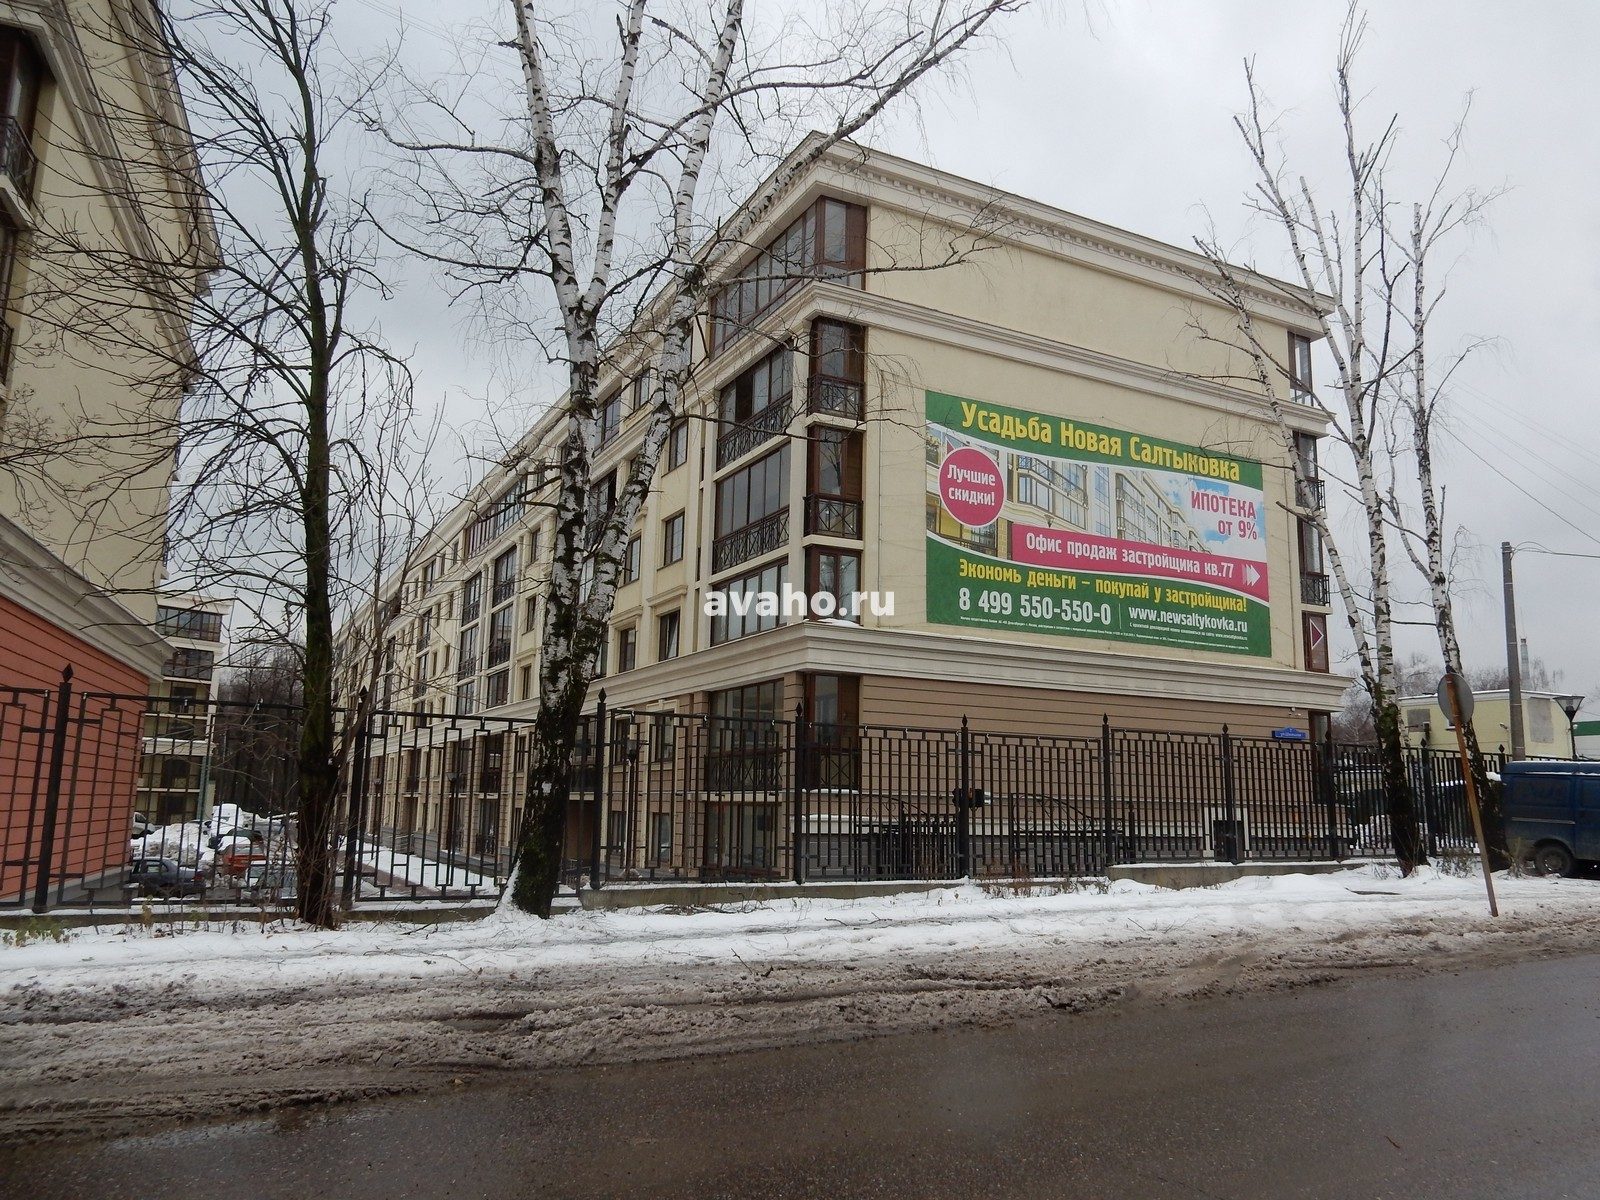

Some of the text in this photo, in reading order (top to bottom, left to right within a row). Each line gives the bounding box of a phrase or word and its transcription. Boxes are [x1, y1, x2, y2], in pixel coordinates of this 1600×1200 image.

[961, 402, 1240, 481] Усадьба Новая Салтыковка
[947, 464, 996, 487] Лучшие
[948, 487, 995, 506] скидки!
[1191, 490, 1257, 520] ИПОТЕКА
[1238, 520, 1257, 540] 9%
[1026, 532, 1234, 578] Офис продаж застройщика кв.77
[959, 558, 1022, 583] Экономь
[1027, 571, 1076, 590] деньги
[1095, 579, 1149, 599] покупай
[1154, 586, 1162, 603] у
[1165, 588, 1247, 612] застройщика!
[959, 587, 1111, 625] 8 499 550-550-0
[1128, 606, 1248, 633] www.newsaltykovka.ru
